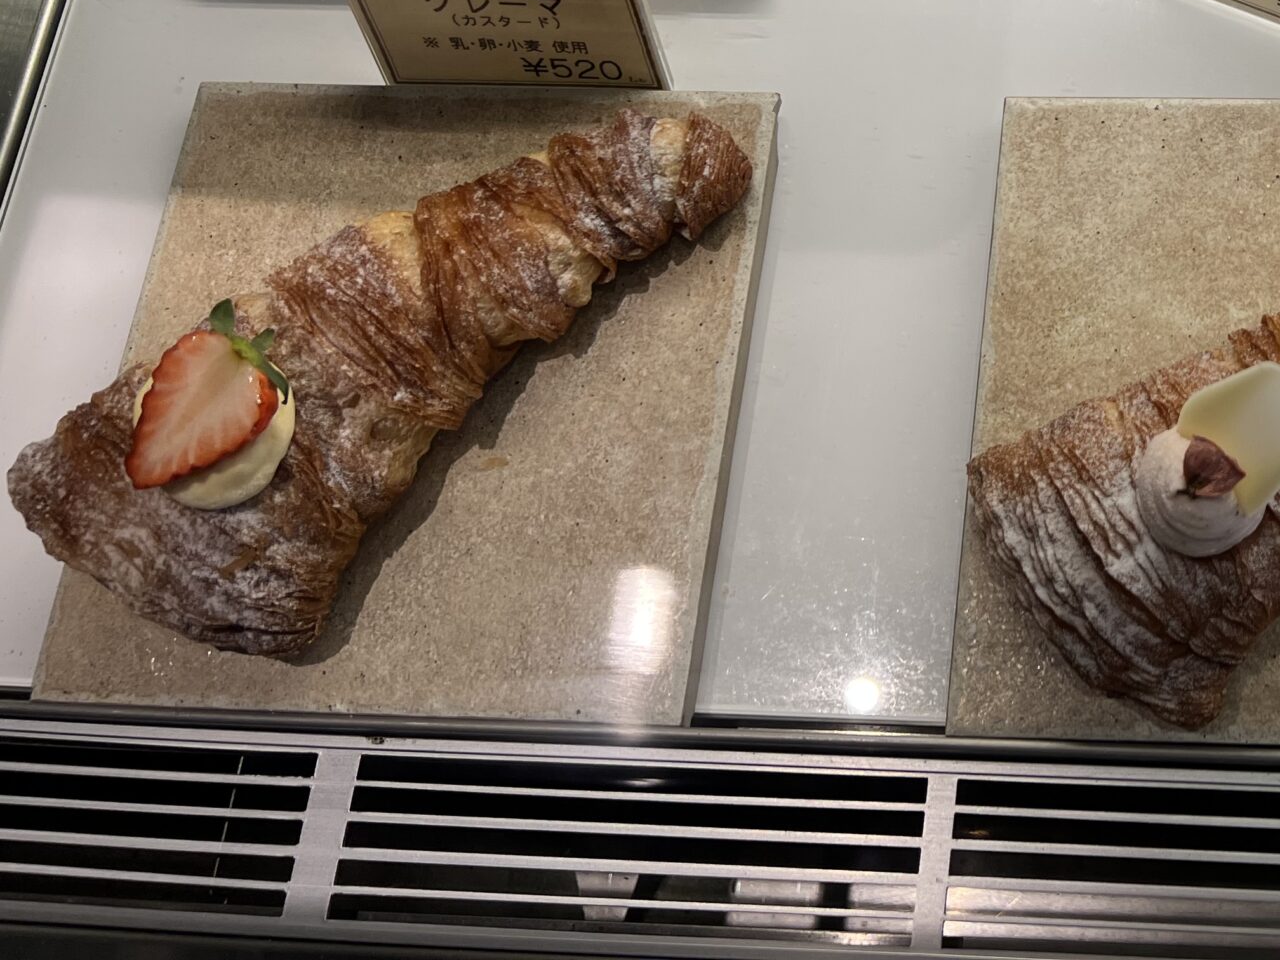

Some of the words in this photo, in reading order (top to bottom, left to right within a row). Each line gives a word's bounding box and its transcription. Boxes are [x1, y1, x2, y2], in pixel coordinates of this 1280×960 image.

[451, 13, 562, 30] （カスタード）
[551, 39, 590, 56] 使用
[520, 57, 623, 81] ¥520
